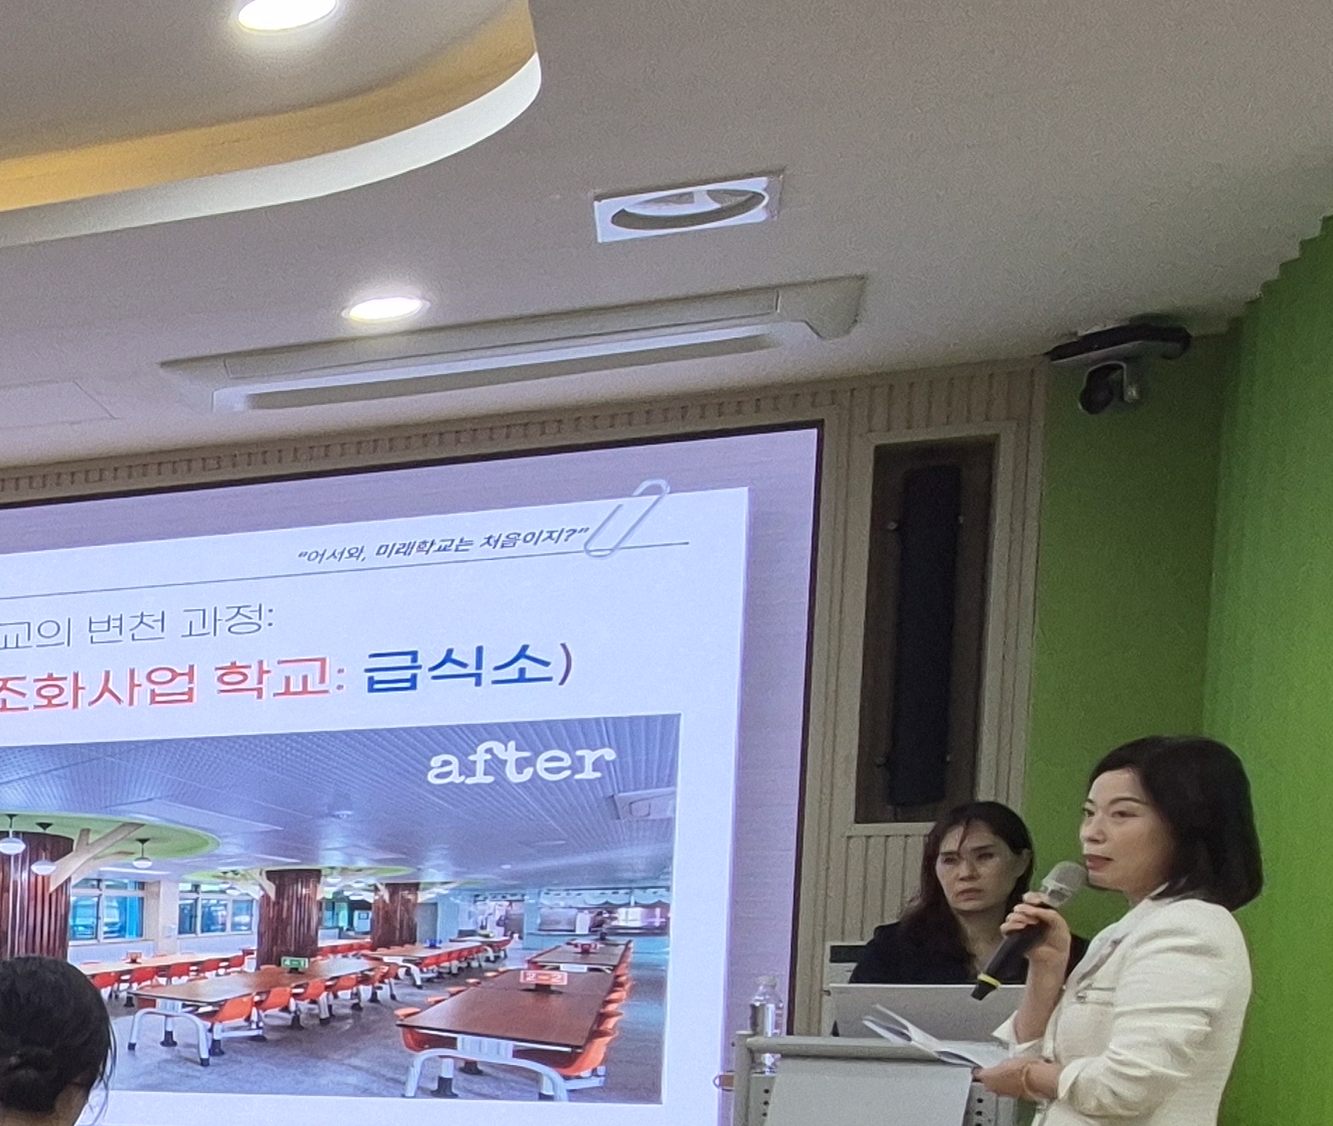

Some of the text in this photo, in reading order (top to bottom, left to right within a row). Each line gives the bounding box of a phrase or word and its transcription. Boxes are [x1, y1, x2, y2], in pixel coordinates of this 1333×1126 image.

[375, 537, 474, 558] 미래학교는
[87, 609, 167, 645] 변천
[180, 602, 275, 640] 과정:
[213, 655, 346, 700] 학교:
[363, 642, 574, 696] 급식소)
[427, 740, 617, 785] after
